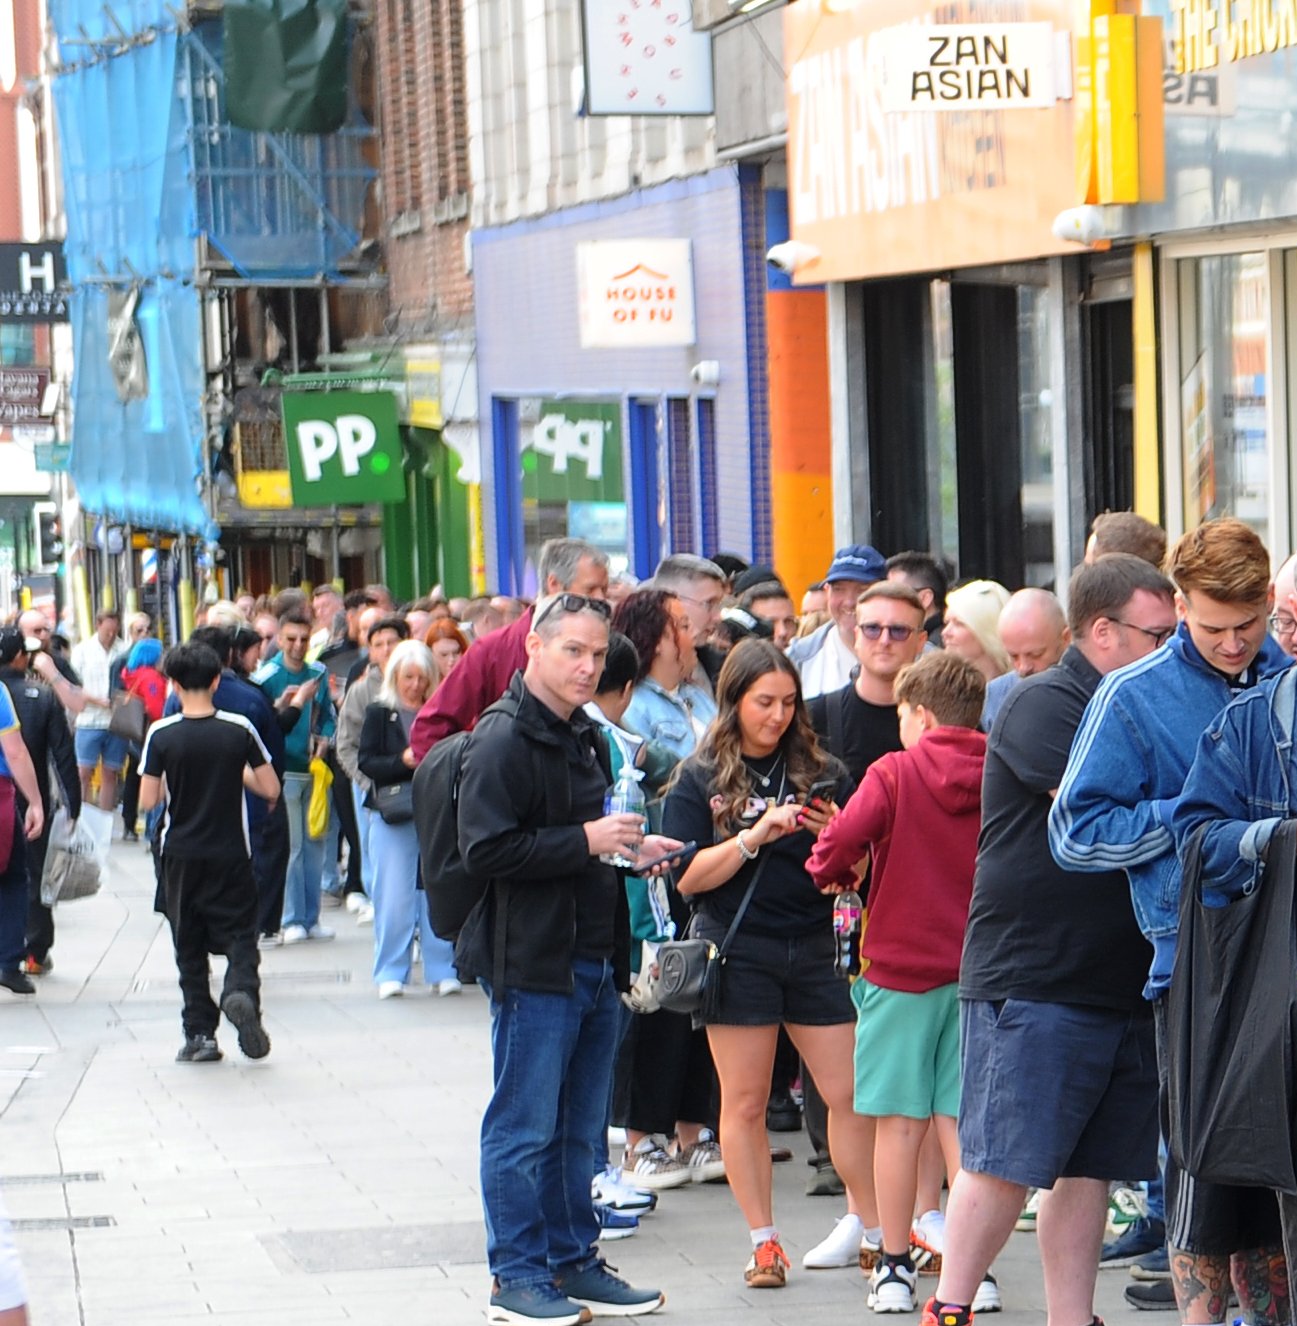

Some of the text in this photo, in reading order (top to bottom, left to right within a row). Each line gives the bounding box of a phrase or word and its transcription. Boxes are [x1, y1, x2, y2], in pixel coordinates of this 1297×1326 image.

[928, 35, 1008, 67] ZAN
[910, 67, 1030, 101] ASIAN
[19, 251, 55, 294] H
[606, 286, 676, 301] HOUSE
[612, 307, 673, 323] OF FU
